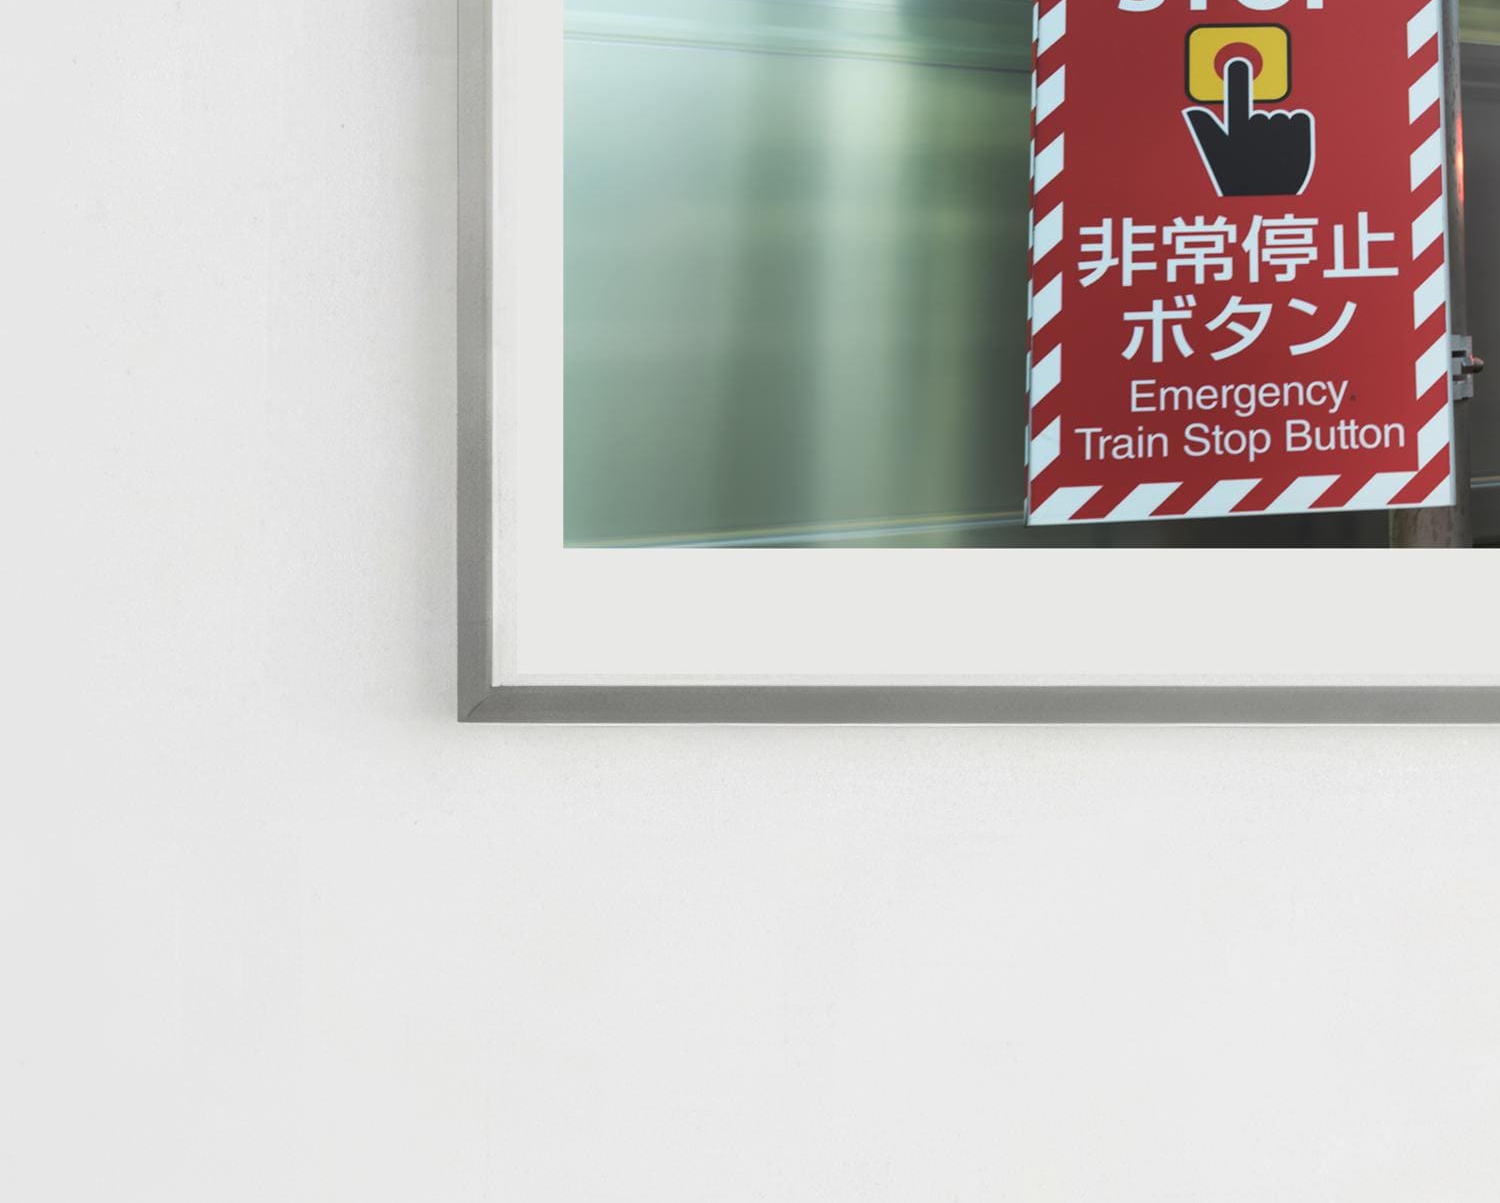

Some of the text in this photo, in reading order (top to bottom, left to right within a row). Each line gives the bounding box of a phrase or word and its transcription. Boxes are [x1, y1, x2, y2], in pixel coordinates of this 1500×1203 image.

[1077, 211, 1400, 288] 非常停止
[1121, 294, 1357, 363] ボタン
[1130, 379, 1349, 417] Emergency
[1074, 418, 1405, 462] Train Stop Button
